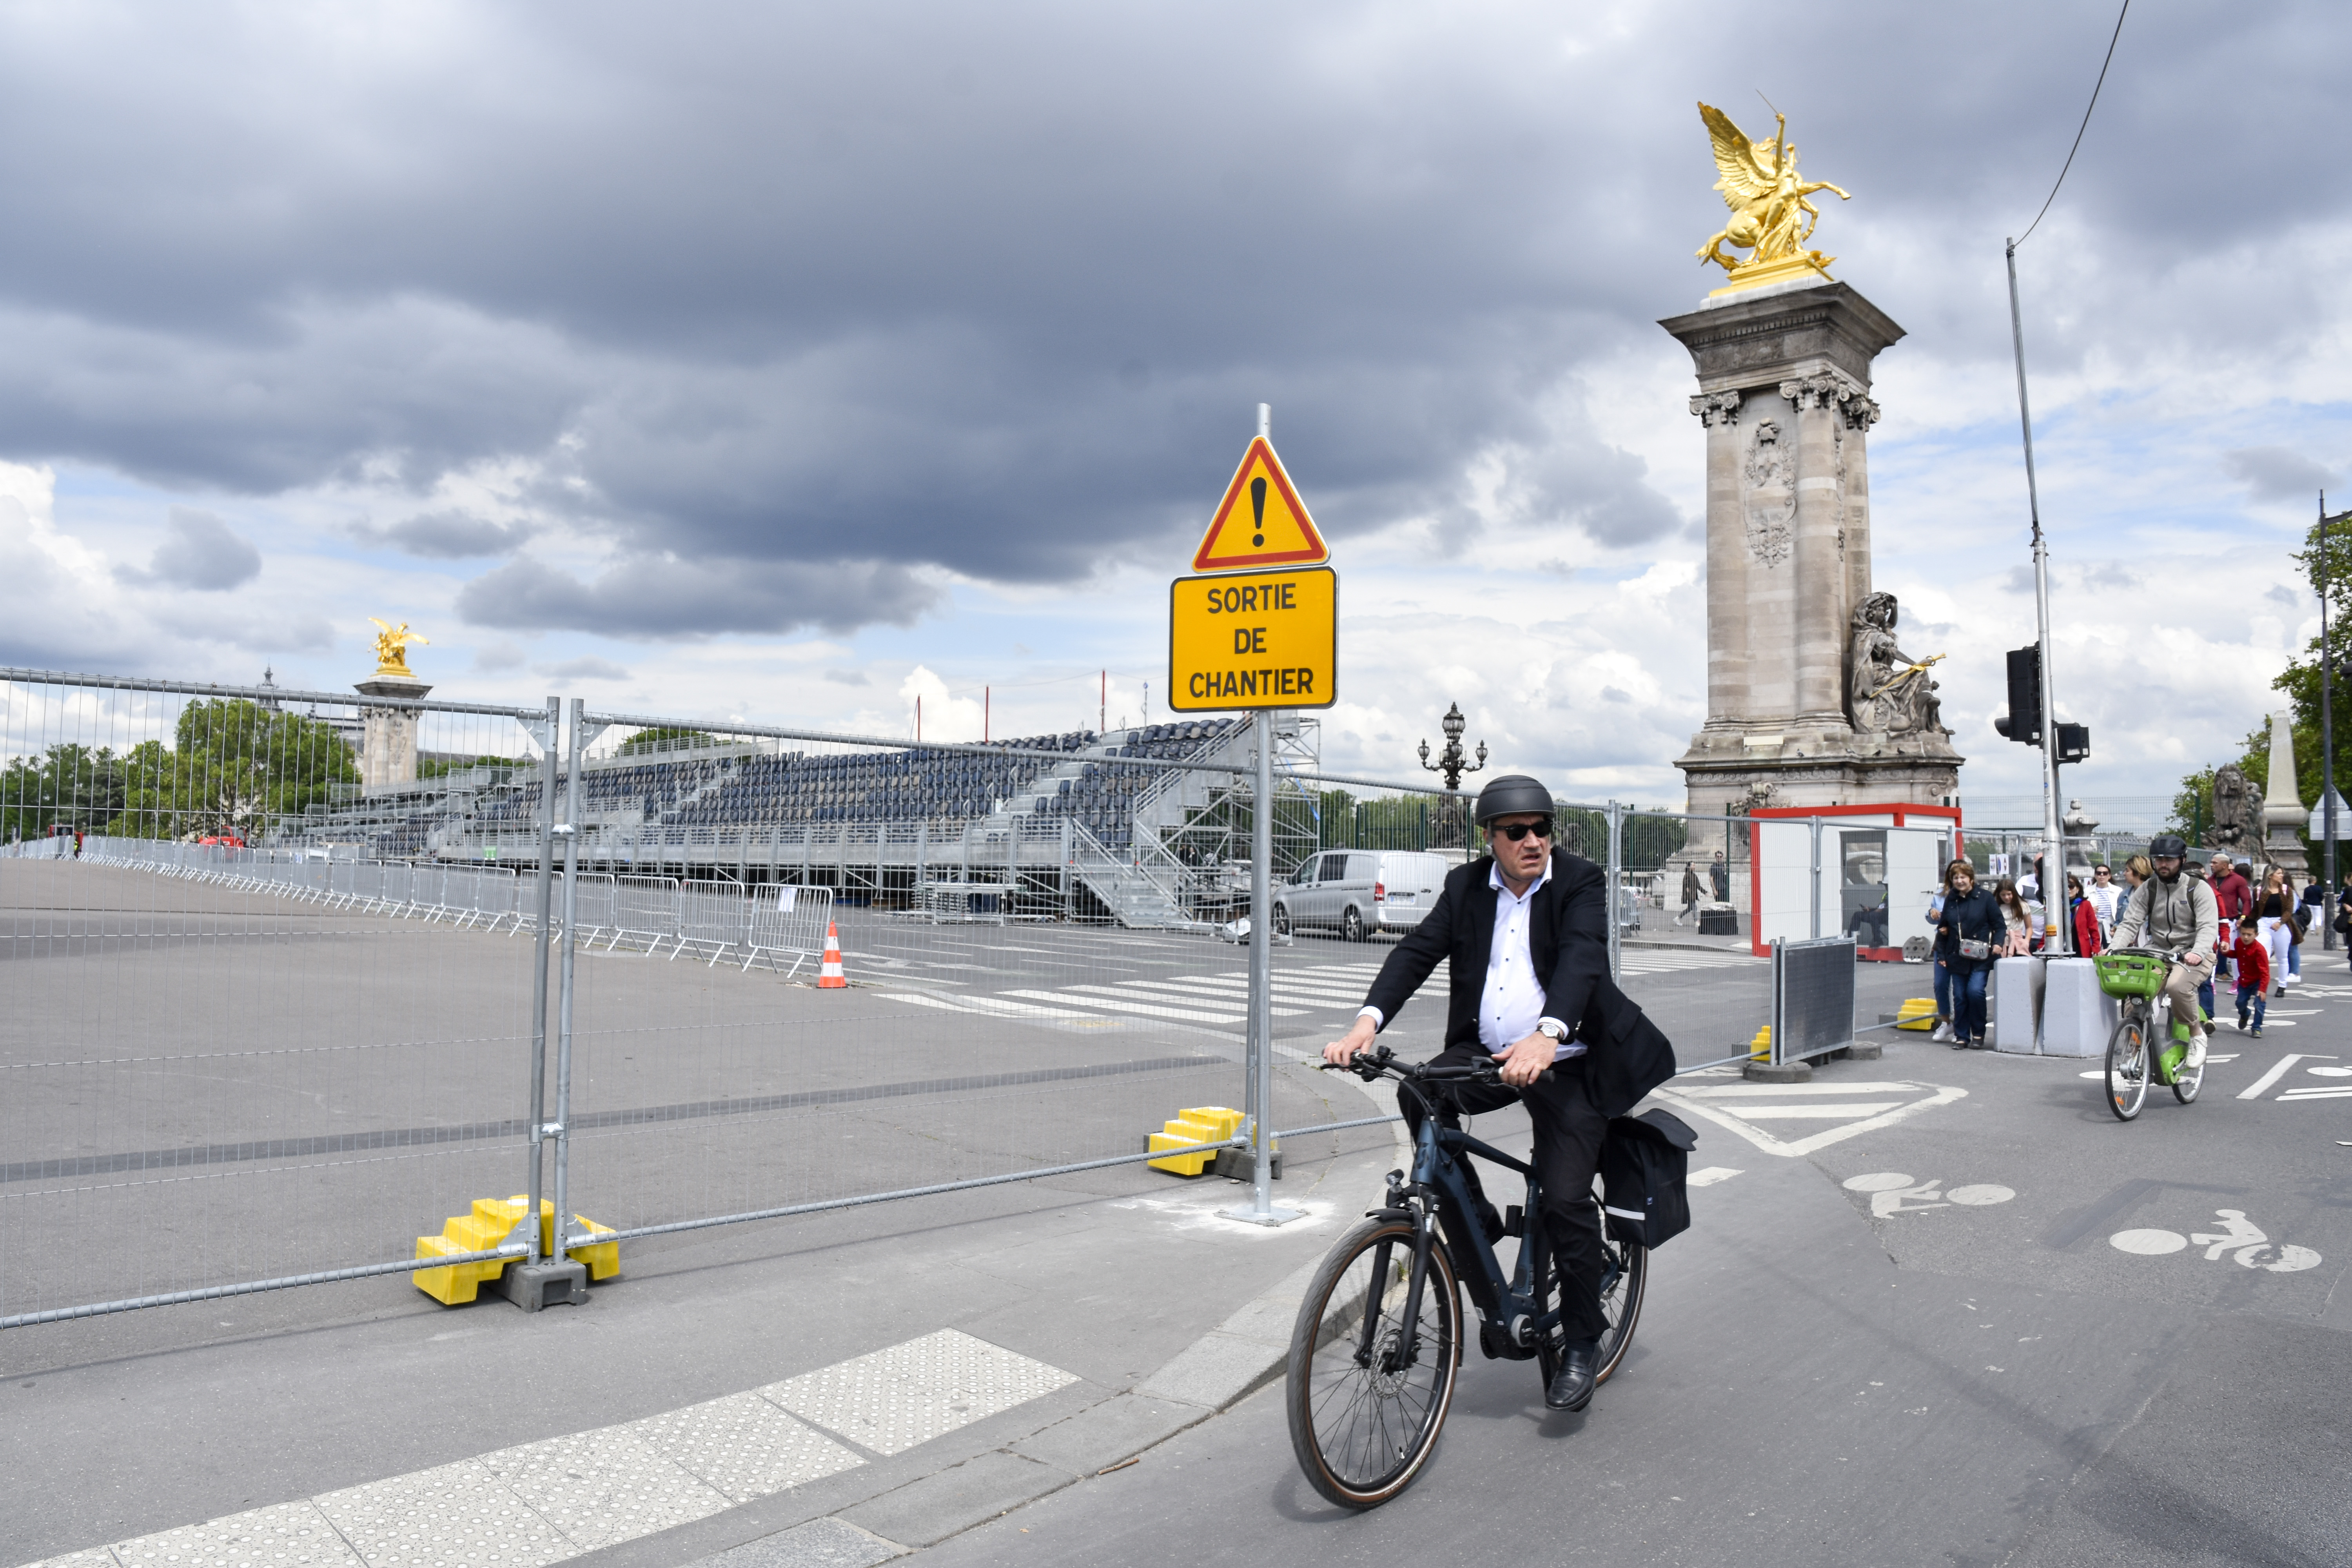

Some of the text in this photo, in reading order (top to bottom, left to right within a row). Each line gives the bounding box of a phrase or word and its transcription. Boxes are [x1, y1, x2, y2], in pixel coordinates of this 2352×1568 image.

[1207, 583, 1296, 614] SORTIE
[1234, 628, 1267, 654] DE
[1189, 668, 1313, 698] CHANTIER
